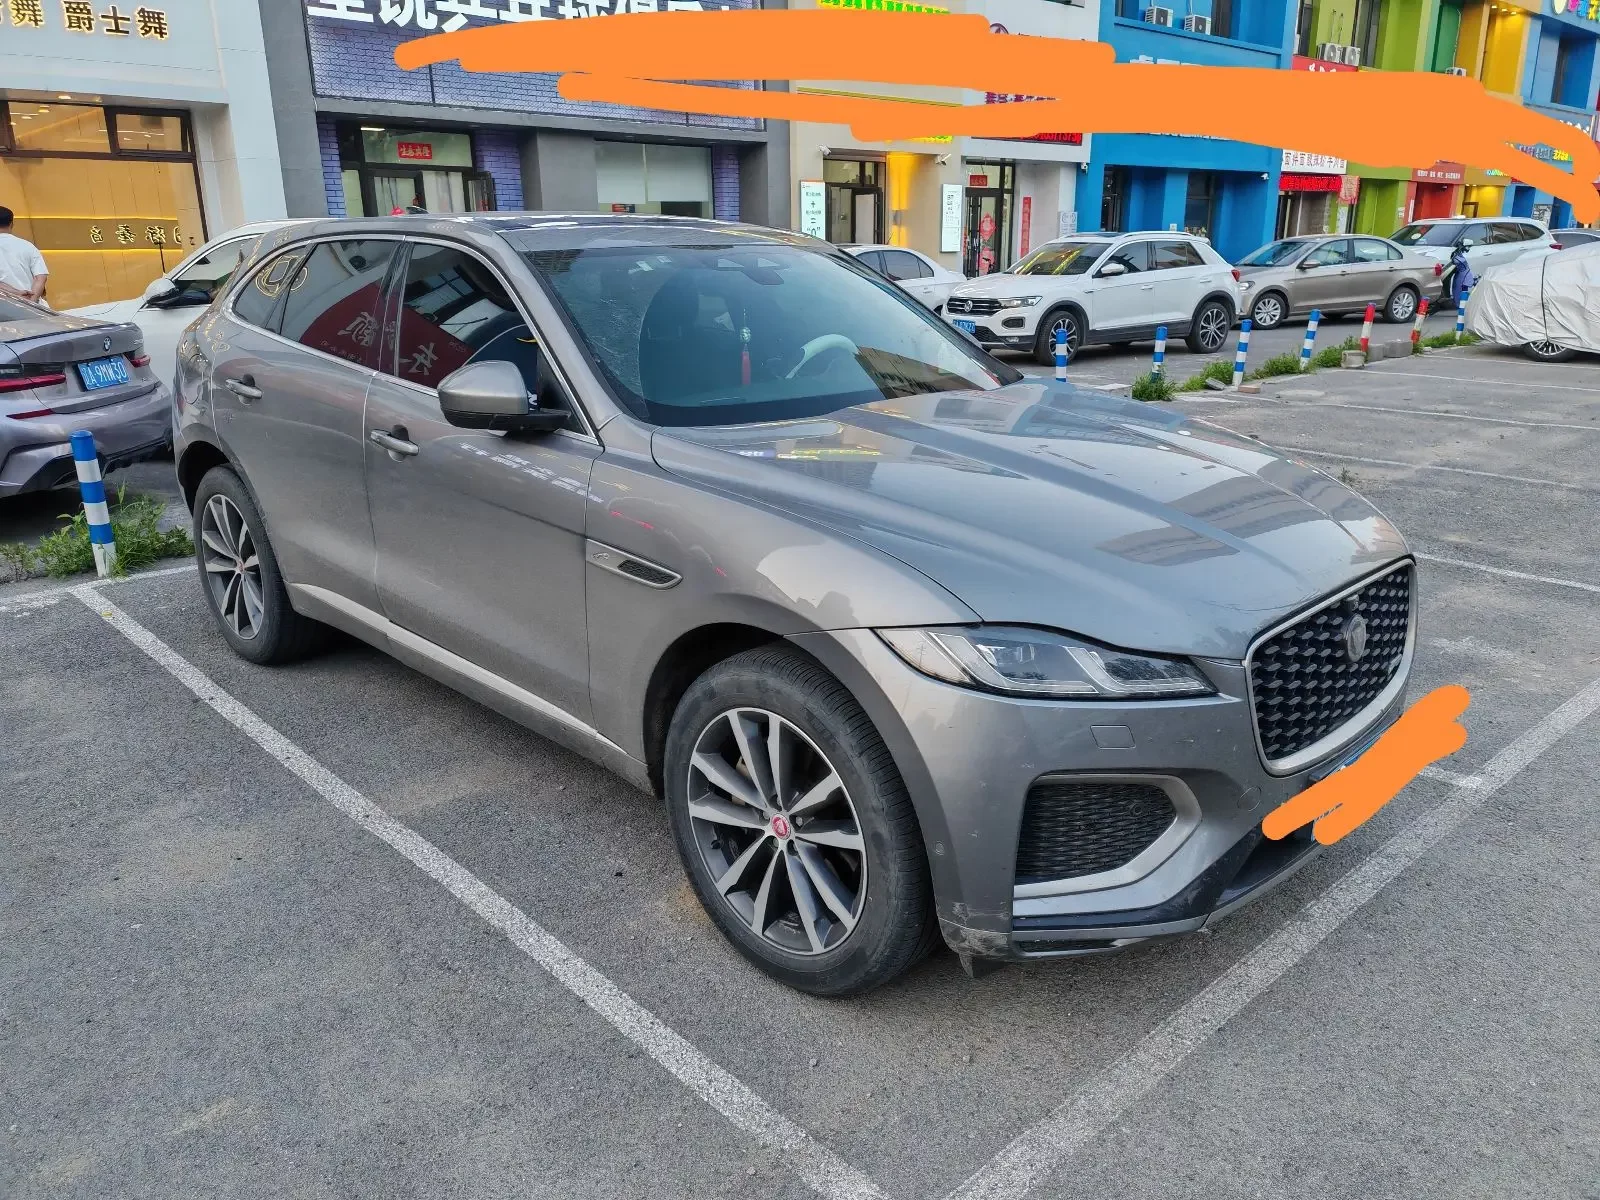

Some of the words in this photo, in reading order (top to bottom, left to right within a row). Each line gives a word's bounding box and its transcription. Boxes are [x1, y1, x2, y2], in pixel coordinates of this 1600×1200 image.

[0, 0, 43, 27] 舞
[63, 0, 168, 39] 爵士舞
